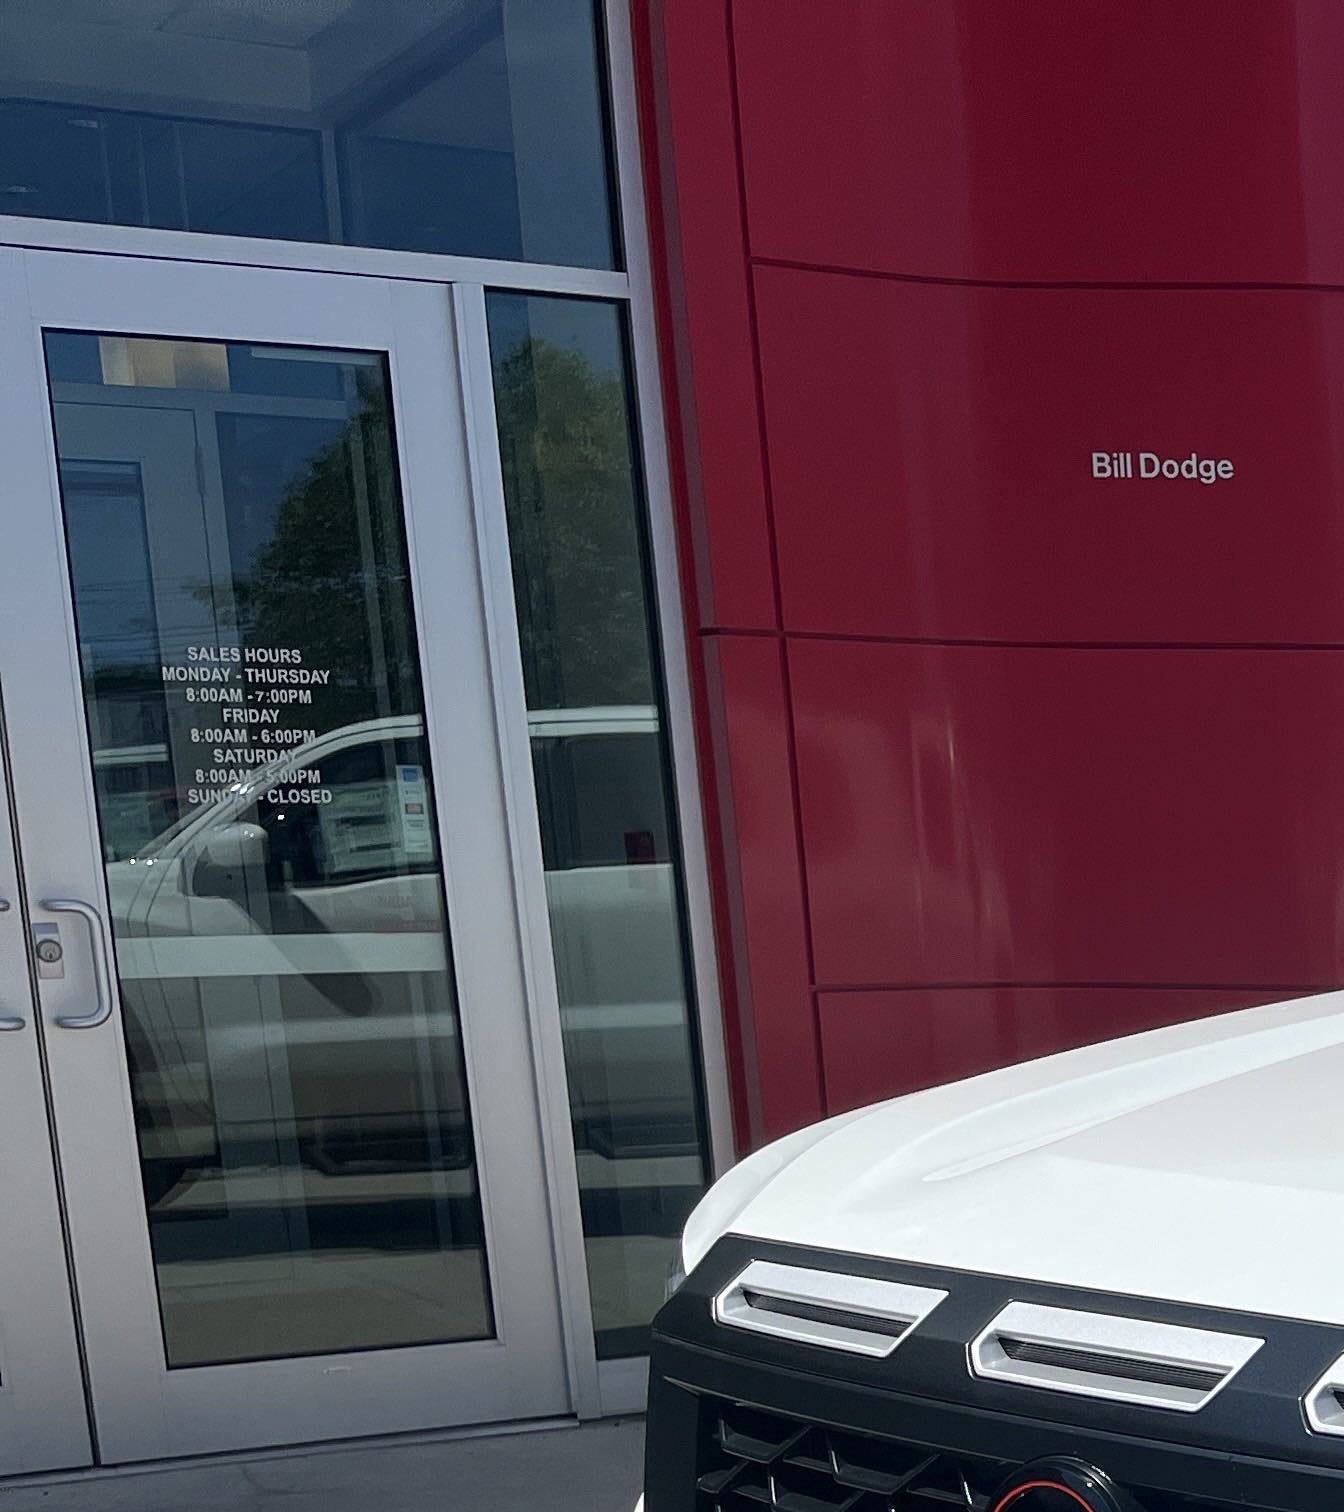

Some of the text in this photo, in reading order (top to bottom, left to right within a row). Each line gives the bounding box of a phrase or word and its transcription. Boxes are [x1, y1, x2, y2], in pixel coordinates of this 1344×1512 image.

[1092, 452, 1234, 484] Bill Dodge
[187, 646, 302, 664] SALES HOURS
[162, 666, 231, 682] MONDAY
[244, 668, 330, 685] THURSDAY
[186, 687, 243, 703] 8:00AM
[255, 689, 312, 704] 7:00PM
[223, 708, 280, 724] FRIDAY
[190, 728, 248, 744] 8:00AM
[261, 729, 316, 744] 6:00PM
[214, 749, 298, 764] SATURDAY
[195, 768, 250, 784] 8:00AM
[188, 788, 252, 804] SUND
[267, 789, 332, 804] CLOSED
